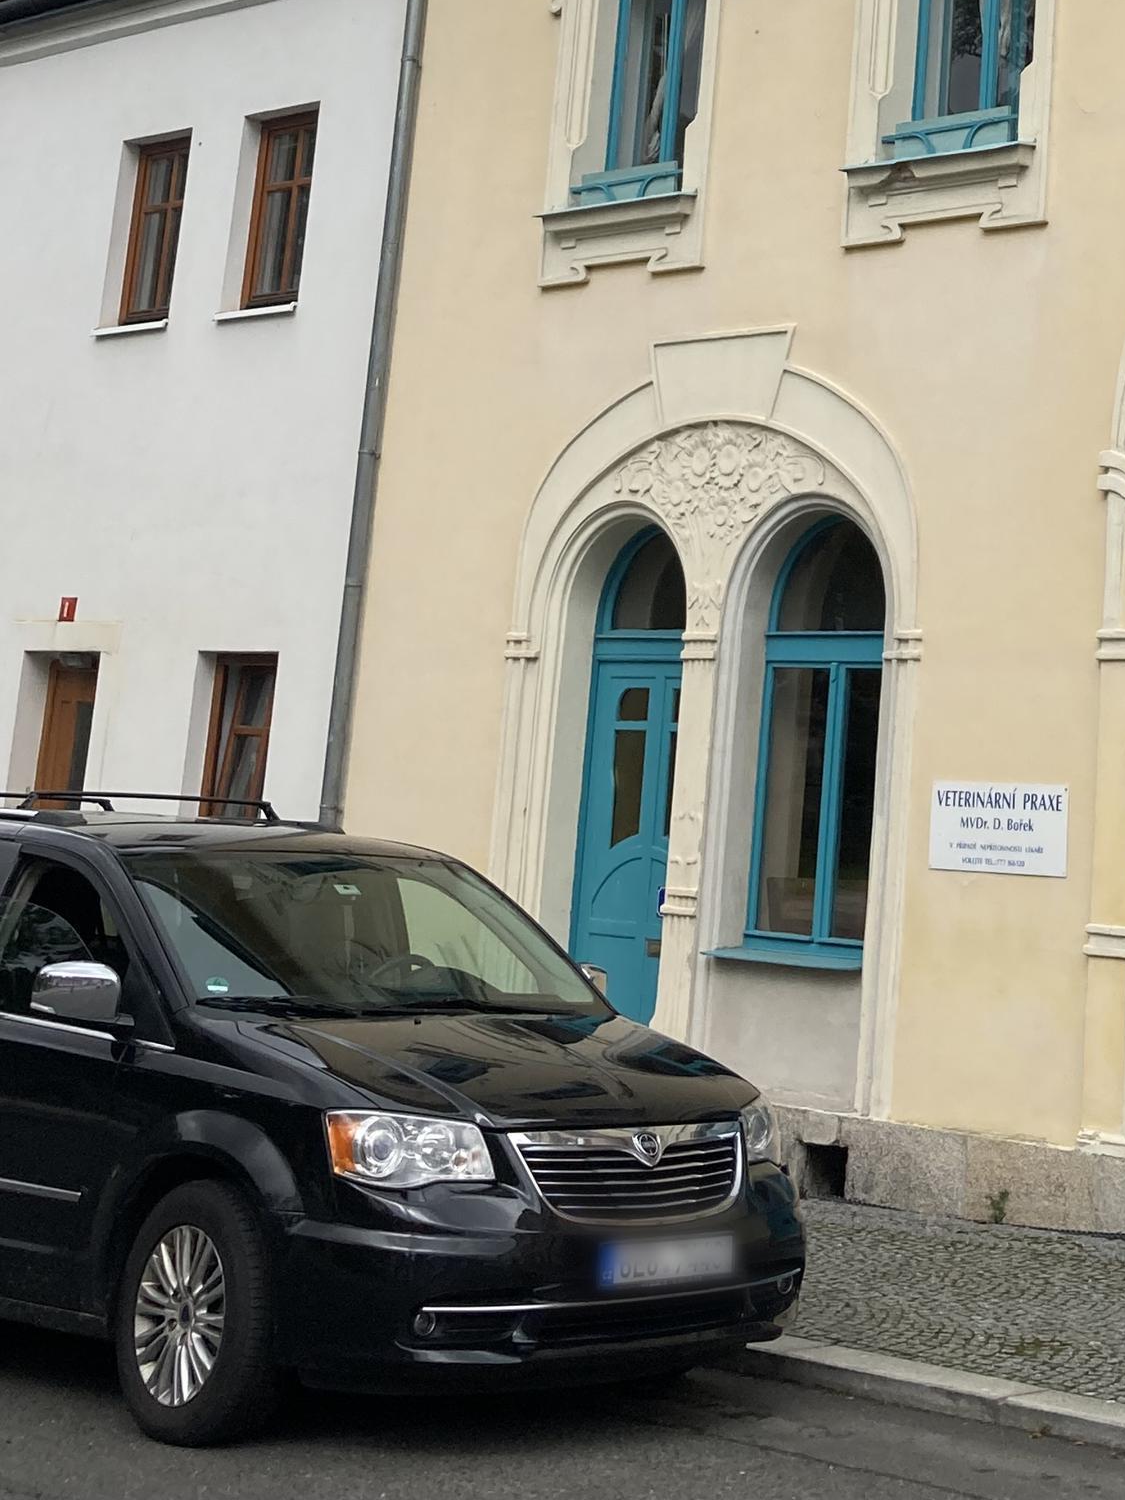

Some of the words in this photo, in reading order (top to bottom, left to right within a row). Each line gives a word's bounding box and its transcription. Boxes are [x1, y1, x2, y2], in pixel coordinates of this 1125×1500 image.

[937, 787, 1017, 810] VETERINÁRNÍ
[1023, 793, 1062, 812] PRAXE
[960, 816, 989, 830] MVDr.
[993, 818, 1003, 831] D.
[1007, 818, 1034, 832] Bořek
